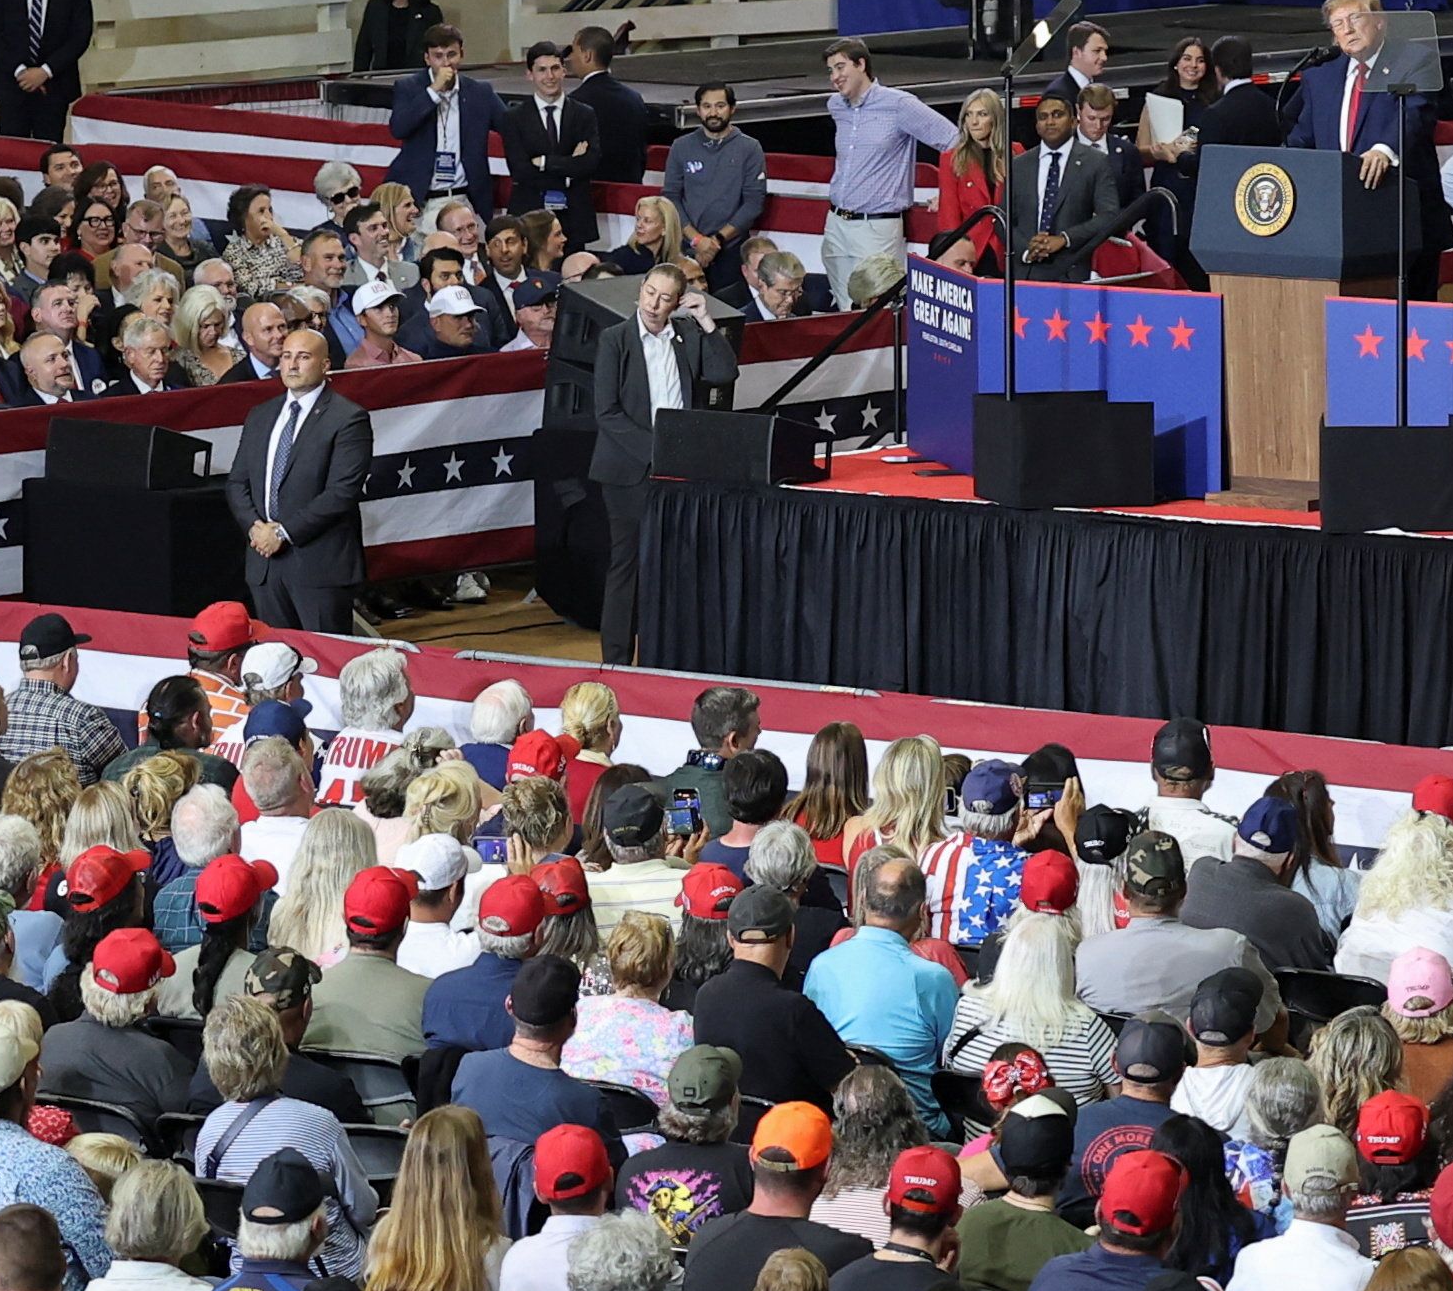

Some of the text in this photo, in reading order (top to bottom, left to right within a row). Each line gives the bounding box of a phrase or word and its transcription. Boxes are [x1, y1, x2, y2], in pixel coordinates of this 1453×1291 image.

[910, 268, 974, 314] MAKE AMERICA
[914, 298, 972, 341] GREAT AGAIN!
[1405, 983, 1431, 994] TRUMP
[1092, 1131, 1153, 1164] ONE MORE
[1367, 1135, 1401, 1144] TRUMP
[904, 1175, 937, 1186] TRUMP
